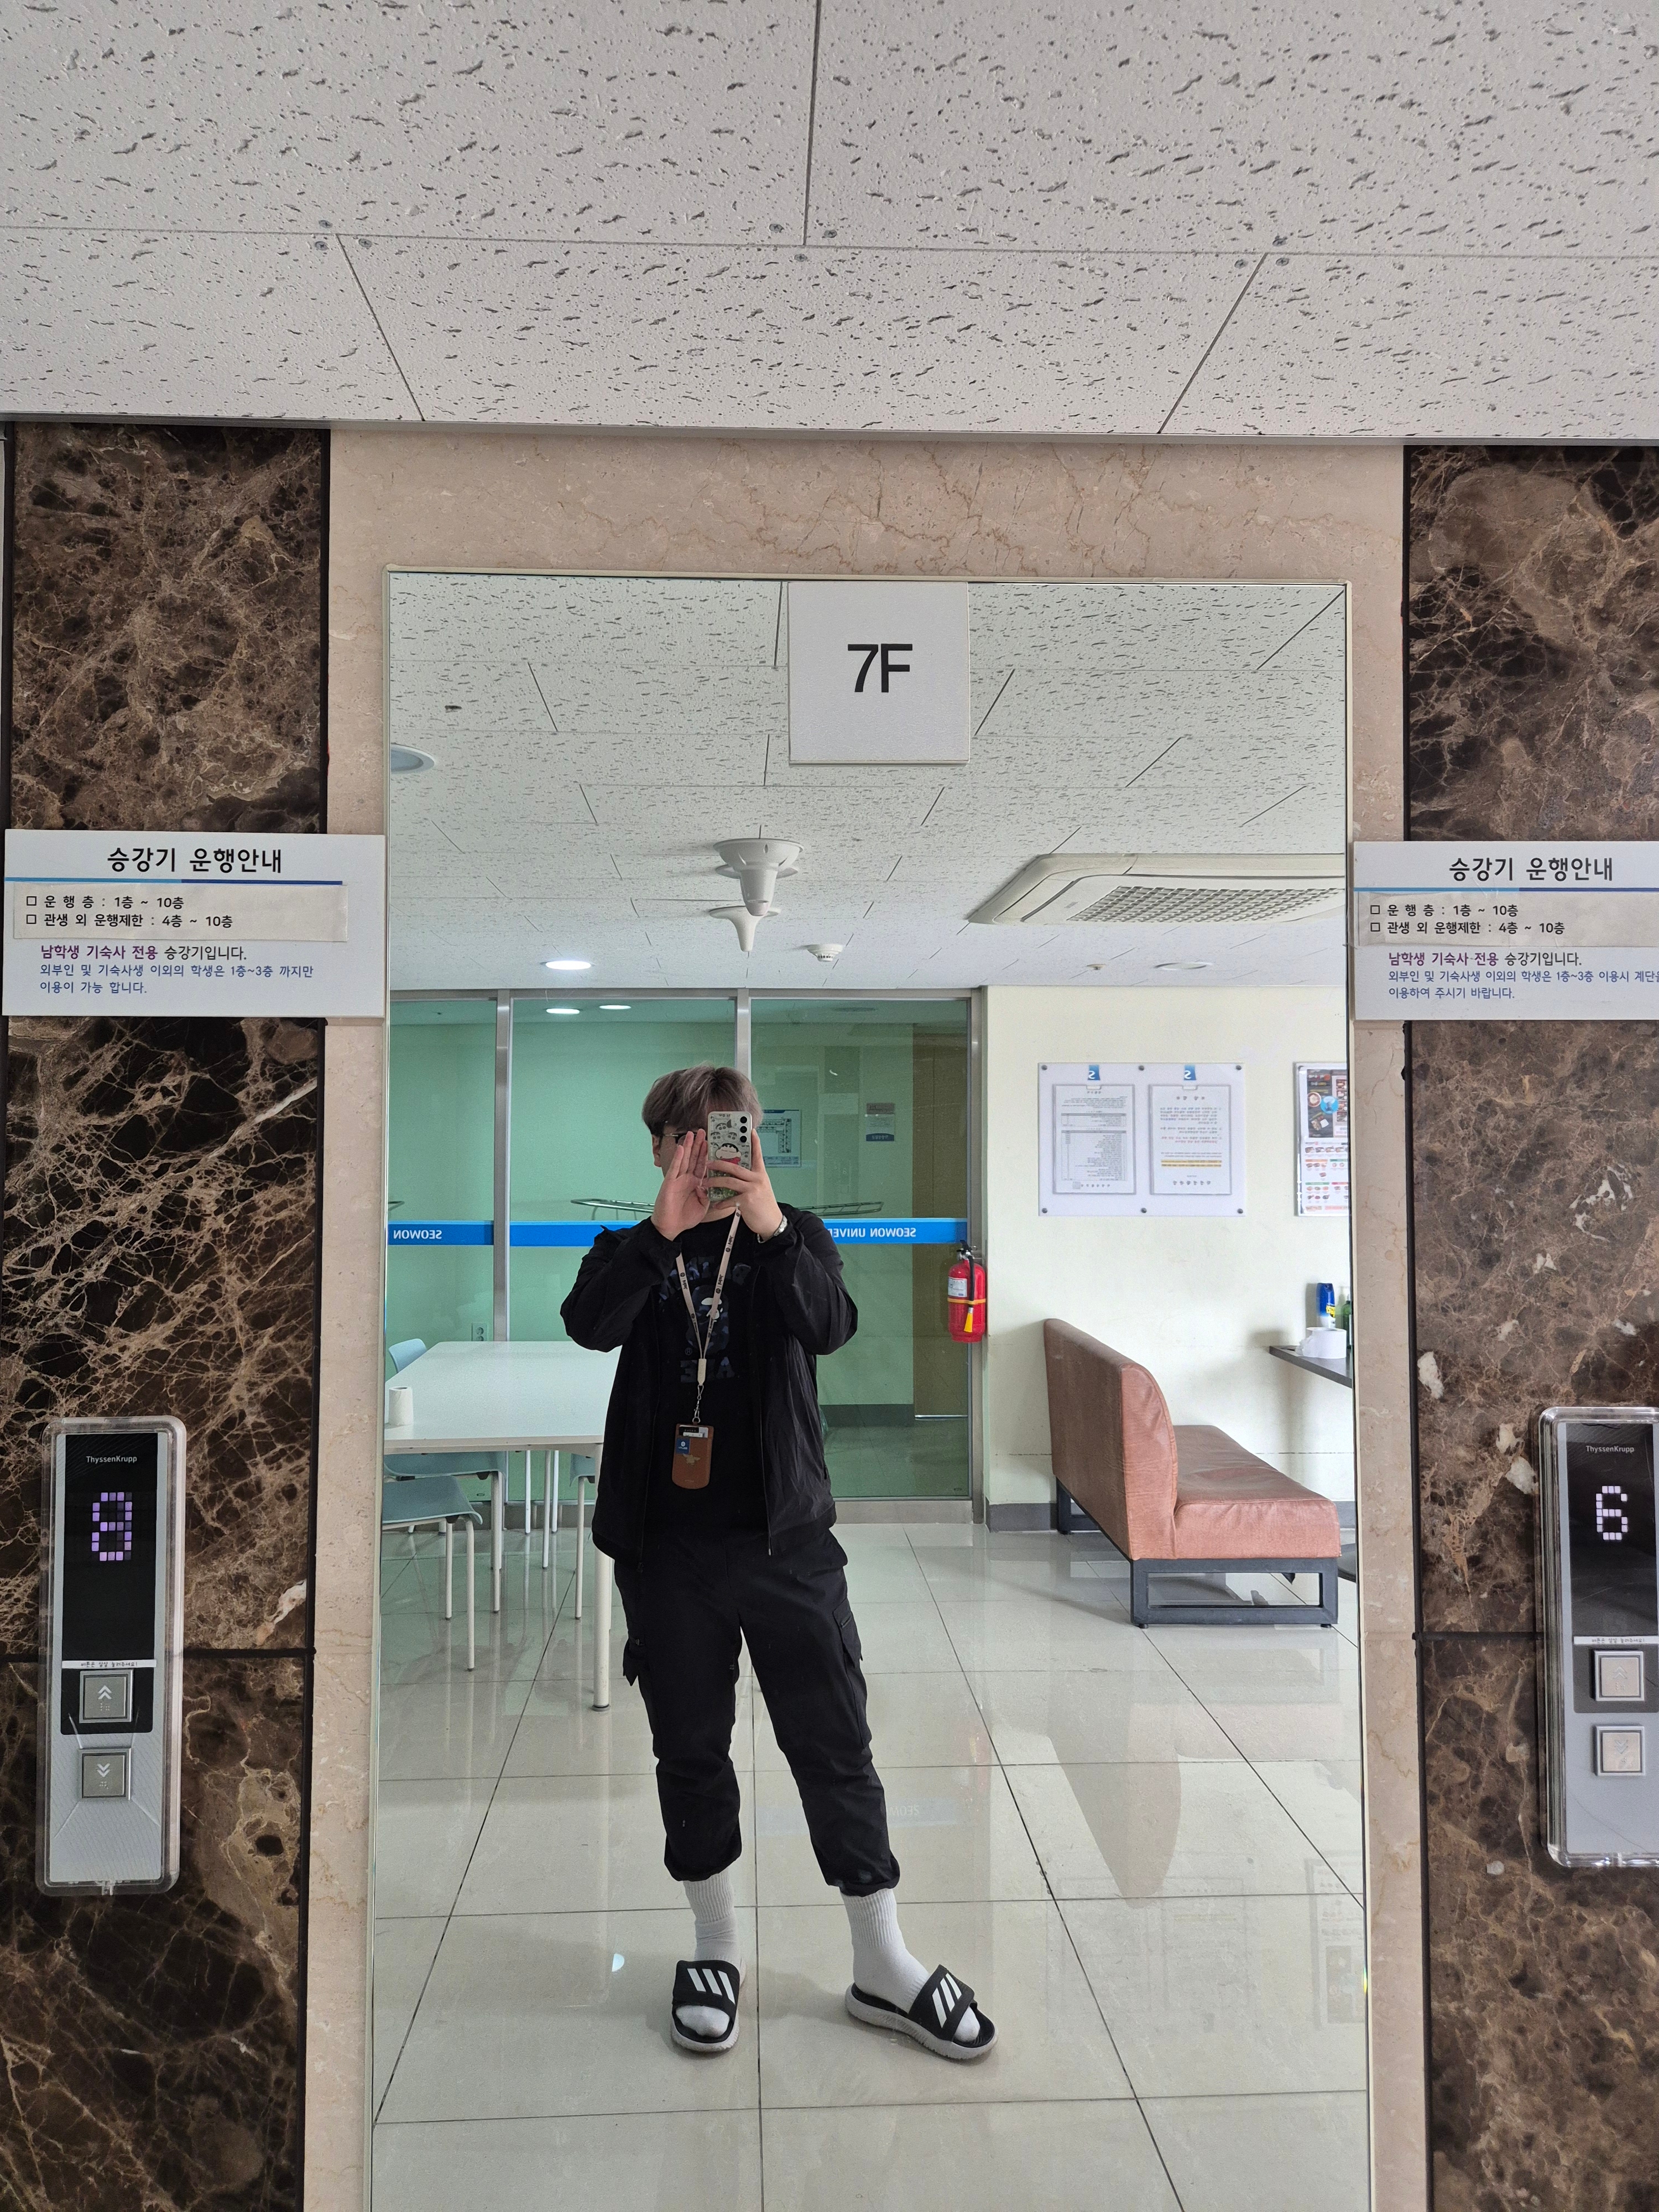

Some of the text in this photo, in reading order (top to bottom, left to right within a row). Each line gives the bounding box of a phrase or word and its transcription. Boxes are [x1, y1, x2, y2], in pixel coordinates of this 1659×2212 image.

[848, 644, 912, 693] 7F
[107, 847, 281, 874] 승강기 운행안내
[1449, 857, 1613, 882] 승강기 운행안내
[44, 895, 56, 908] 운
[63, 895, 75, 909] 행
[82, 895, 95, 909] 층
[114, 895, 134, 909] 1층
[156, 896, 184, 910] 10층
[1387, 904, 1399, 916] 운
[1405, 904, 1416, 917] 행
[1423, 904, 1434, 917] 층
[1453, 904, 1472, 917] 1층
[1493, 904, 1519, 917] 10층
[44, 913, 68, 927] 관생
[75, 913, 86, 926] 외
[94, 914, 144, 927] 운행제한
[161, 914, 182, 928] 4층
[205, 915, 233, 928] 10층
[1387, 921, 1410, 935] 관생
[1416, 921, 1427, 935] 외
[1434, 921, 1481, 935] 운행제한
[1499, 921, 1519, 935] 4층
[1539, 921, 1565, 935] 10층
[41, 945, 247, 961] 남학생 기숙사 전용 승강기입니다.
[1389, 952, 1582, 967] 남학생 기숙사 전용 승강기입니다.
[40, 963, 314, 978] 외부인 및 기숙사생 이외의 학생은 1층~3층 까지만
[1388, 970, 1419, 983] 외부인
[1425, 971, 1434, 982] 및
[1439, 971, 1480, 983] 기숙사생
[1485, 971, 1516, 982] 이외의
[1521, 970, 1552, 983] 학생은
[1556, 970, 1594, 983] 1층~3층
[1599, 971, 1629, 983] 이용시
[40, 981, 147, 994] 이용이 가능 합니다.
[1389, 987, 1515, 999] 이용하여 주시기 바랍니다.
[1585, 1445, 1635, 1453] ThyssenKrupp
[86, 1455, 137, 1464] ThyssenKrupp
[1595, 1485, 1628, 1541] 6
